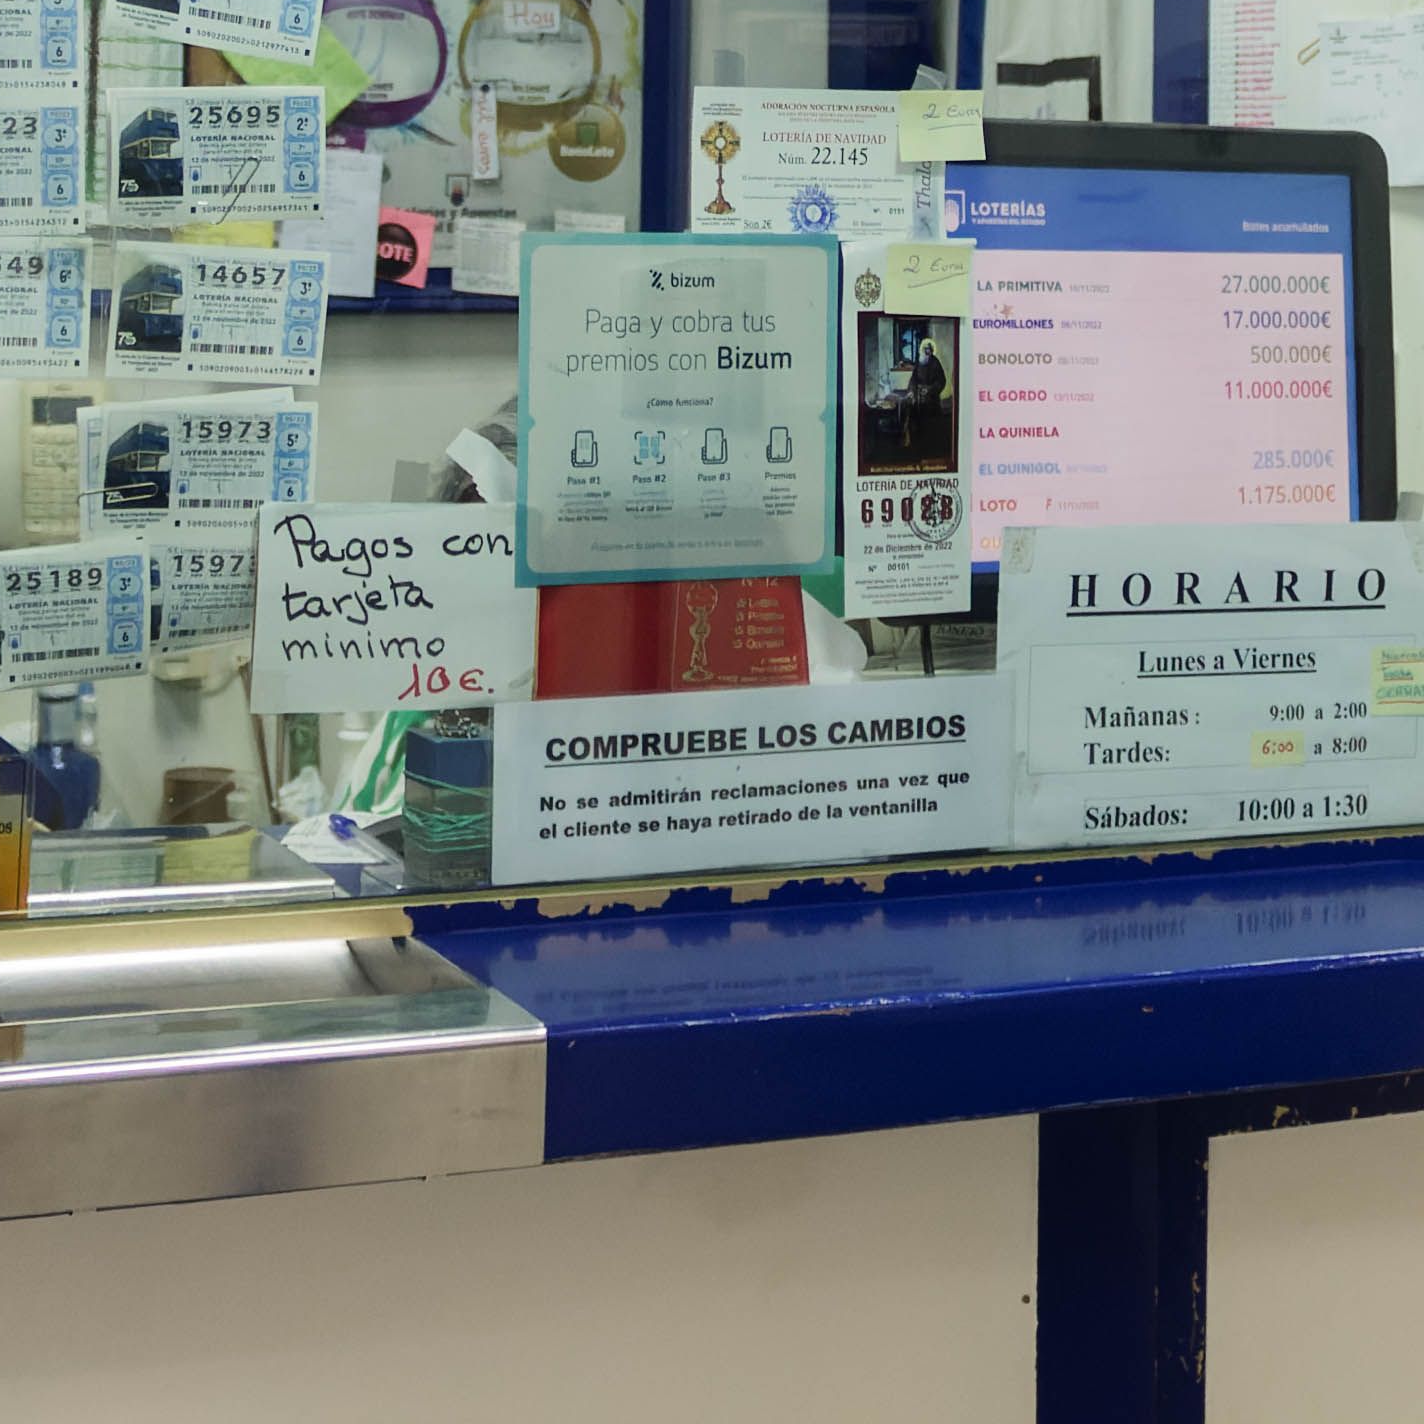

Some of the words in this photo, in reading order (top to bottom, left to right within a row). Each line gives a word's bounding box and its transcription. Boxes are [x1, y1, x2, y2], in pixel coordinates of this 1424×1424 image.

[188, 103, 282, 126] 25695
[762, 131, 813, 144] LOTERÍA
[816, 133, 832, 144] DE
[834, 133, 887, 145] NAVIDAD
[778, 151, 807, 166] Núm.
[810, 146, 869, 166] 22.145
[970, 199, 1047, 217] LOTERÍAS
[670, 272, 715, 288] bizum
[976, 280, 993, 292] LA
[998, 279, 1063, 292] PRIMITIVA
[1221, 274, 1330, 295] 27.000.000€
[585, 308, 641, 339] Paga
[650, 316, 663, 339] y
[672, 309, 732, 333] cobra
[743, 311, 776, 333] tus
[973, 318, 1054, 330] EUROMILLONES
[1223, 310, 1331, 330] 17.000.000€
[566, 347, 659, 377] premios
[668, 352, 707, 372] con
[717, 345, 793, 370] Bizum
[978, 353, 1053, 366] BONOLOTO
[1250, 344, 1332, 364] 500.000€
[979, 390, 995, 402] EL
[998, 389, 1047, 402] GORDO
[1224, 380, 1333, 400] 11.000.000€
[274, 514, 414, 578] Pagos
[442, 532, 514, 557] con
[6, 567, 104, 592] 25189
[1068, 567, 1387, 608] HORARIO
[282, 574, 434, 626] tarjeta
[1137, 649, 1206, 674] Lunes
[1213, 656, 1224, 671] a
[1233, 646, 1317, 671] Viernes
[1269, 703, 1305, 723] 9:00
[1314, 707, 1324, 722] a
[1333, 702, 1368, 721] 2:00
[546, 727, 748, 763] COMPRUEBE
[758, 723, 817, 750] LOS
[827, 714, 966, 745] CAMBIOS
[1083, 740, 1172, 766] Tardes:
[1261, 738, 1295, 756] 6:00
[1313, 742, 1323, 756] a
[1332, 736, 1368, 754] 8:00
[540, 796, 566, 812] No
[577, 796, 599, 810] se
[609, 787, 701, 808] admitirán
[711, 779, 848, 801] reclamaciones
[857, 777, 889, 791] una
[899, 774, 929, 788] vez
[937, 771, 970, 789] que
[539, 824, 557, 840] el
[564, 819, 631, 838] cliente
[638, 819, 660, 833] se
[667, 814, 712, 833] haya
[718, 807, 792, 827] retirado
[798, 806, 820, 821] de
[827, 804, 843, 819] la
[849, 798, 938, 818] ventanilla
[1084, 805, 1189, 831] Sábados:
[1237, 797, 1296, 822] 10:00
[1302, 802, 1314, 819] a
[1323, 793, 1368, 818] 1:30
